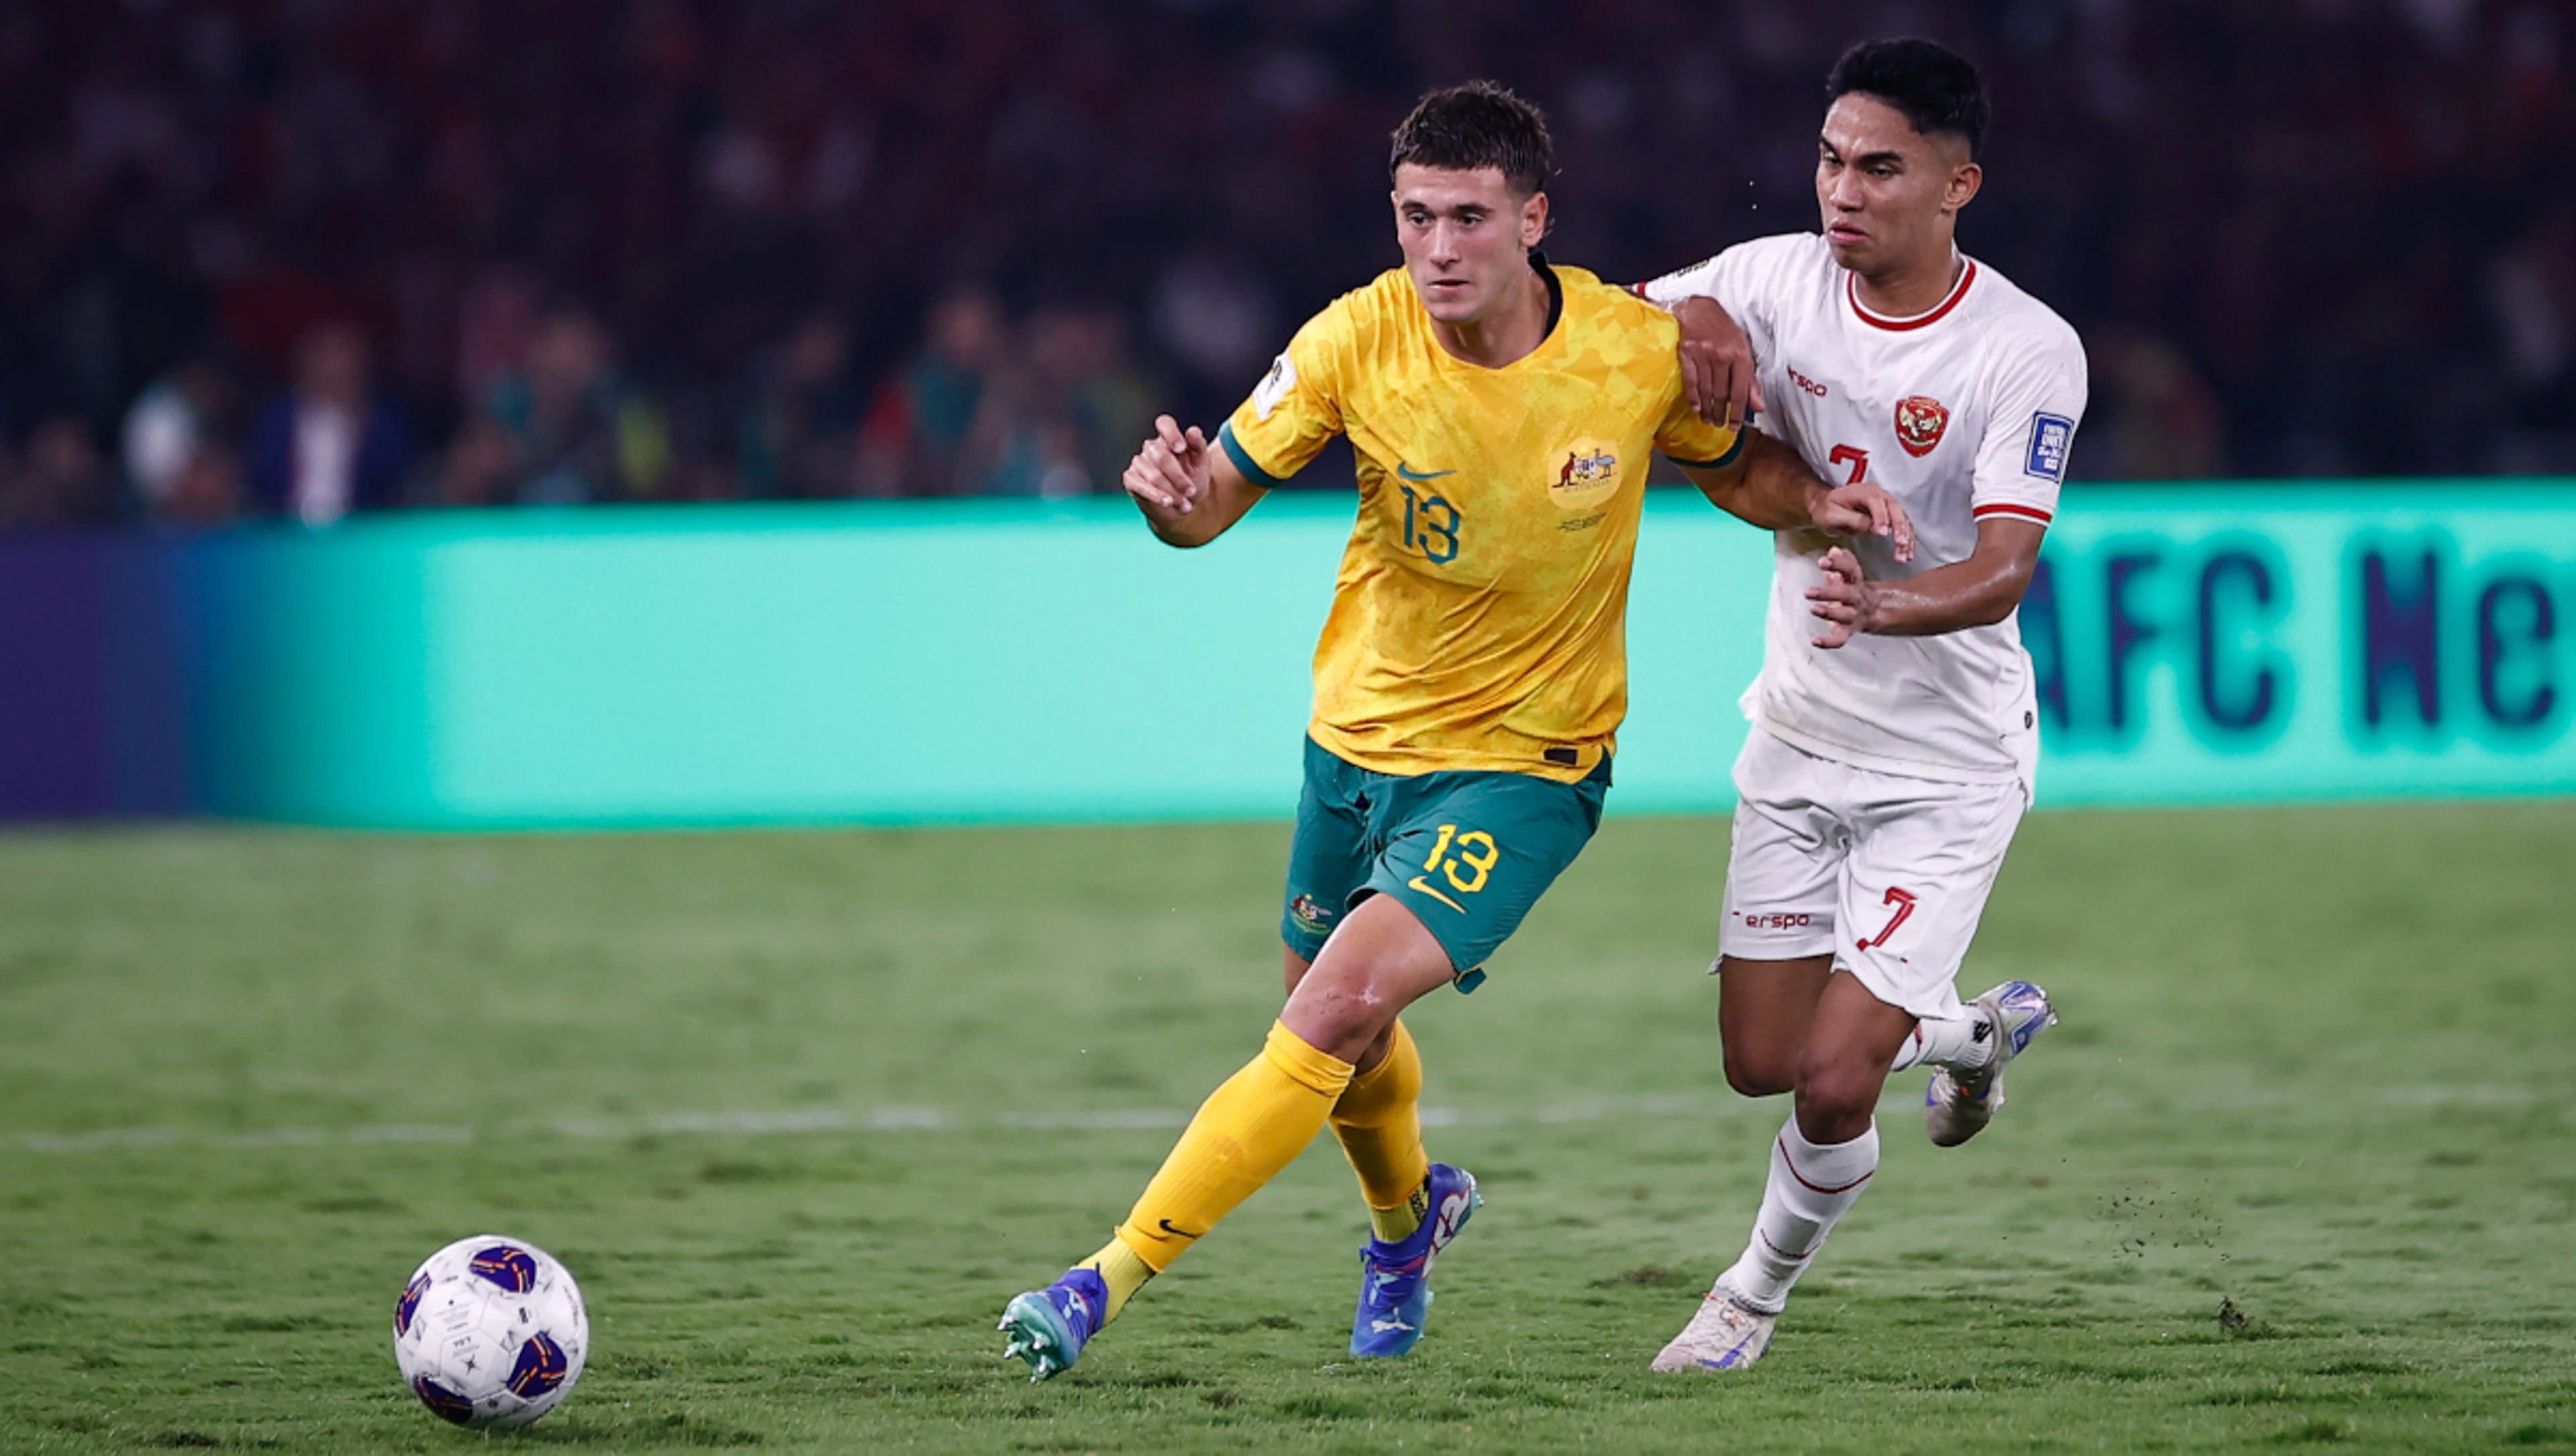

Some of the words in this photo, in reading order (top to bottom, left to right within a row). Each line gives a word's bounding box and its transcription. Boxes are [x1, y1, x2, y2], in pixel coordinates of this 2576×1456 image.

[1829, 443, 1870, 486] 7
[1399, 484, 1461, 564] 13
[1423, 824, 1499, 893] 13
[1746, 915, 1810, 930] erspo
[1856, 886, 1918, 952] 7
